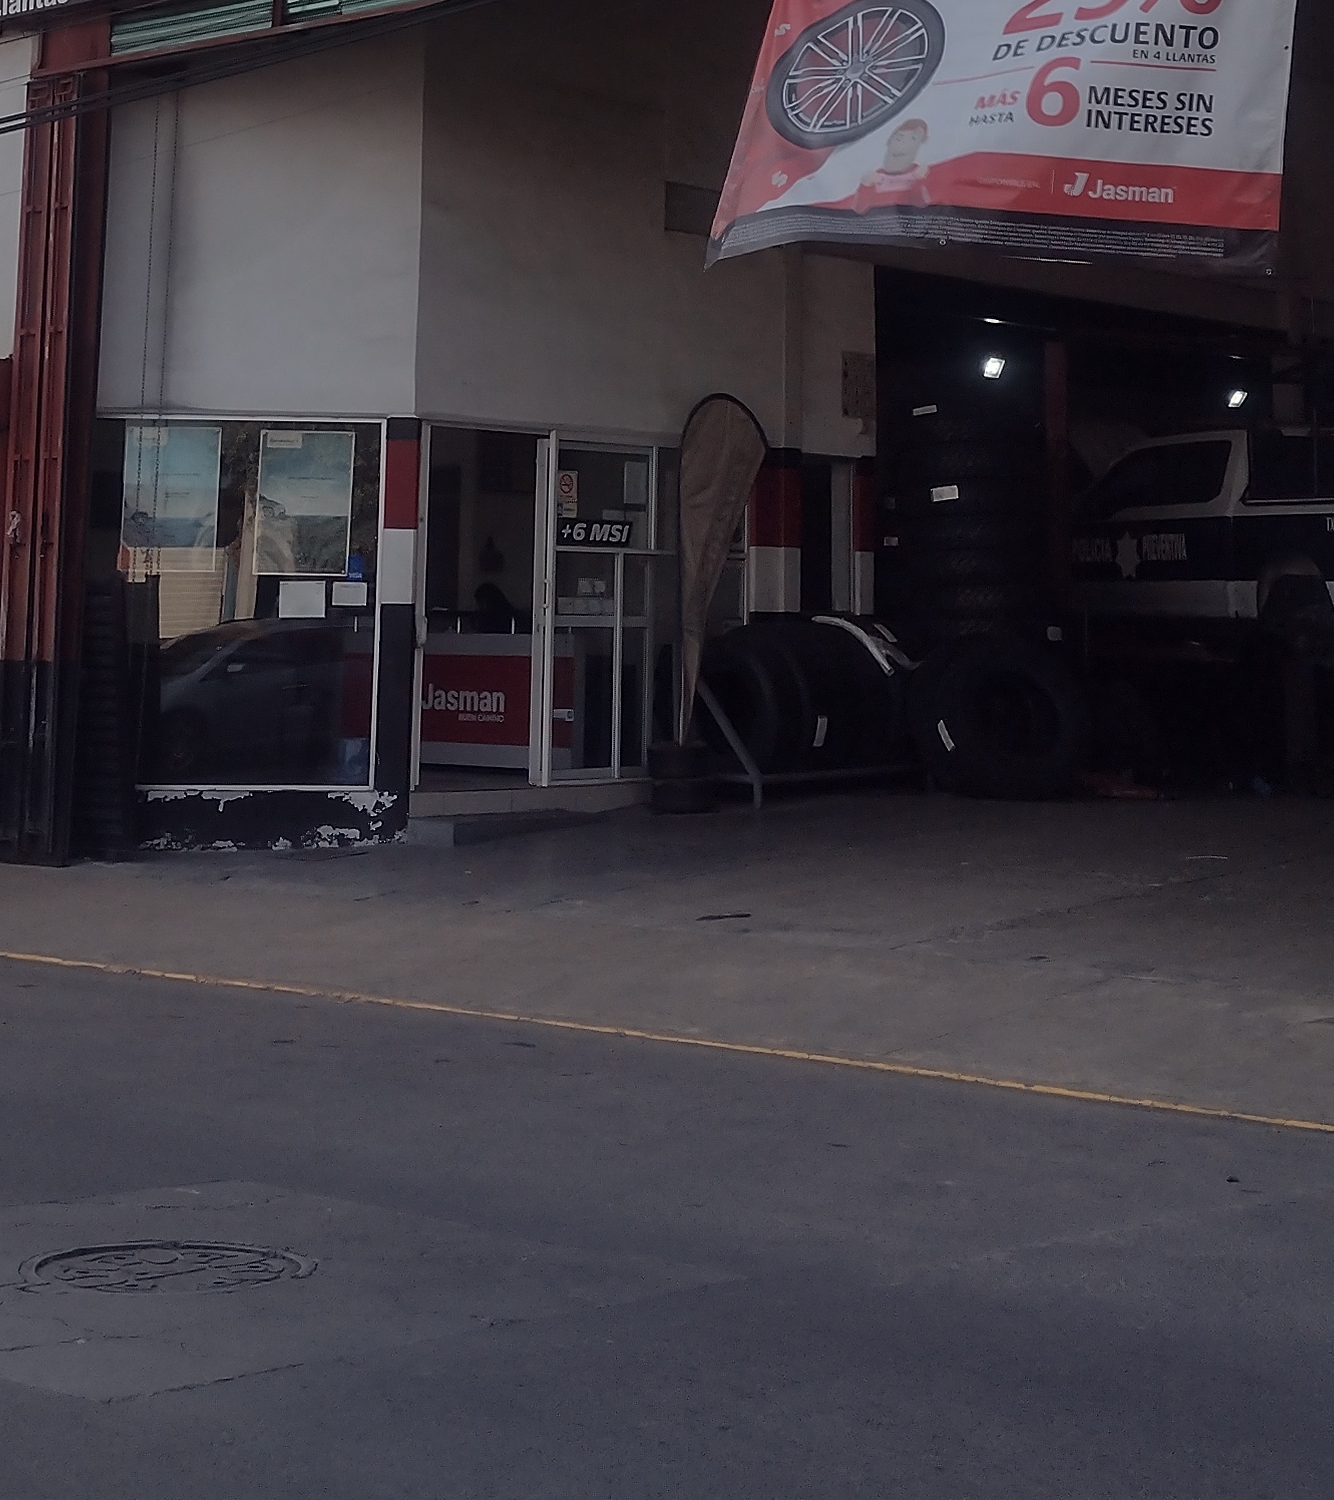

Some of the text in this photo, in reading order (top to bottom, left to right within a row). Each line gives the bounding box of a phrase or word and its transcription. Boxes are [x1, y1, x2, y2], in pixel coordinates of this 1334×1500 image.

[992, 22, 1219, 62] DE DESCUENTO
[1132, 49, 1216, 65] EN 4 LLANTAS
[1025, 56, 1082, 127] 6
[1087, 85, 1214, 113] MESES SIN
[969, 111, 1015, 126] HASTA
[1086, 108, 1213, 137] INTERESES
[1088, 179, 1174, 204] Jasman
[589, 523, 630, 542] MSI
[422, 683, 505, 712] Jasman
